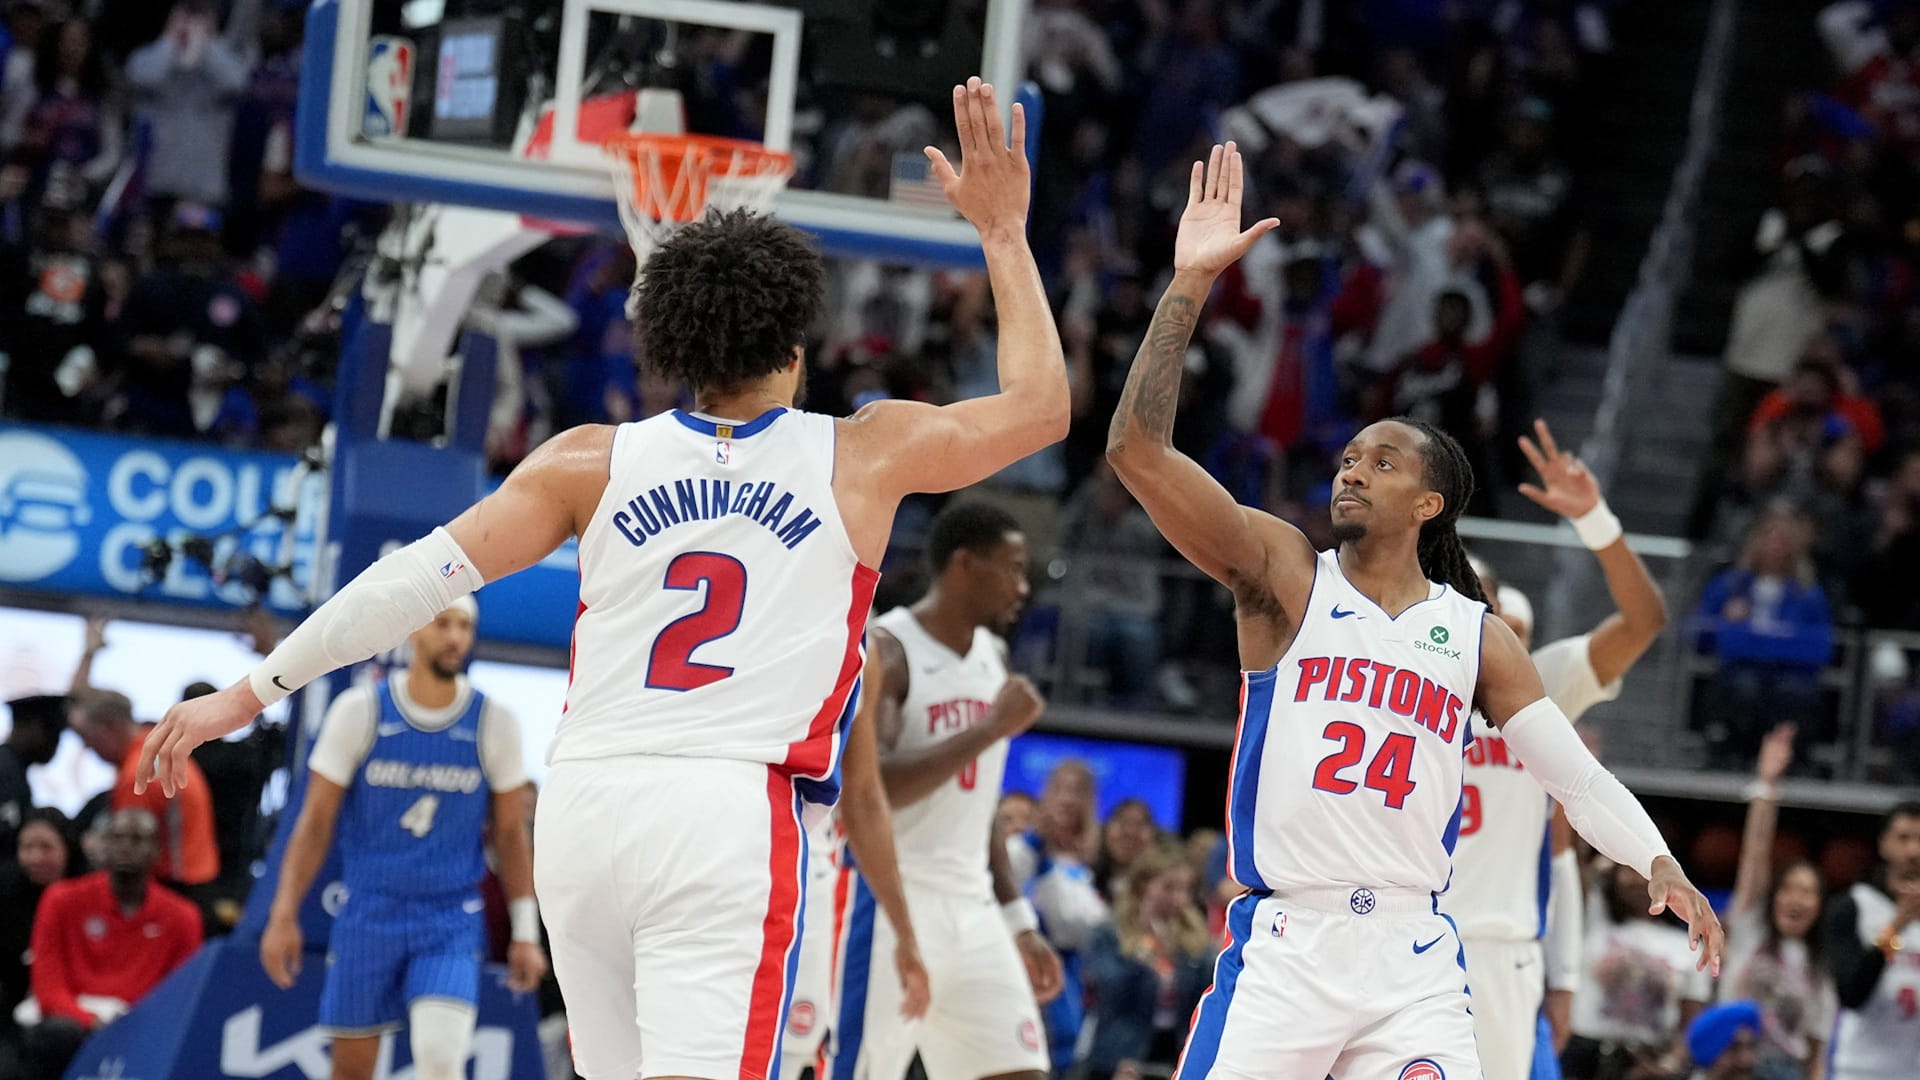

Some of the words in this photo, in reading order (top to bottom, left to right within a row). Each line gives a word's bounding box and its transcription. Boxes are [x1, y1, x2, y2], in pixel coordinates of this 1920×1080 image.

[612, 478, 822, 550] CUNNINGHAM
[644, 550, 748, 692] 2
[1414, 640, 1461, 661] StockX
[1293, 656, 1464, 744] PISTONS
[1312, 720, 1417, 810] 24
[400, 794, 439, 838] 4
